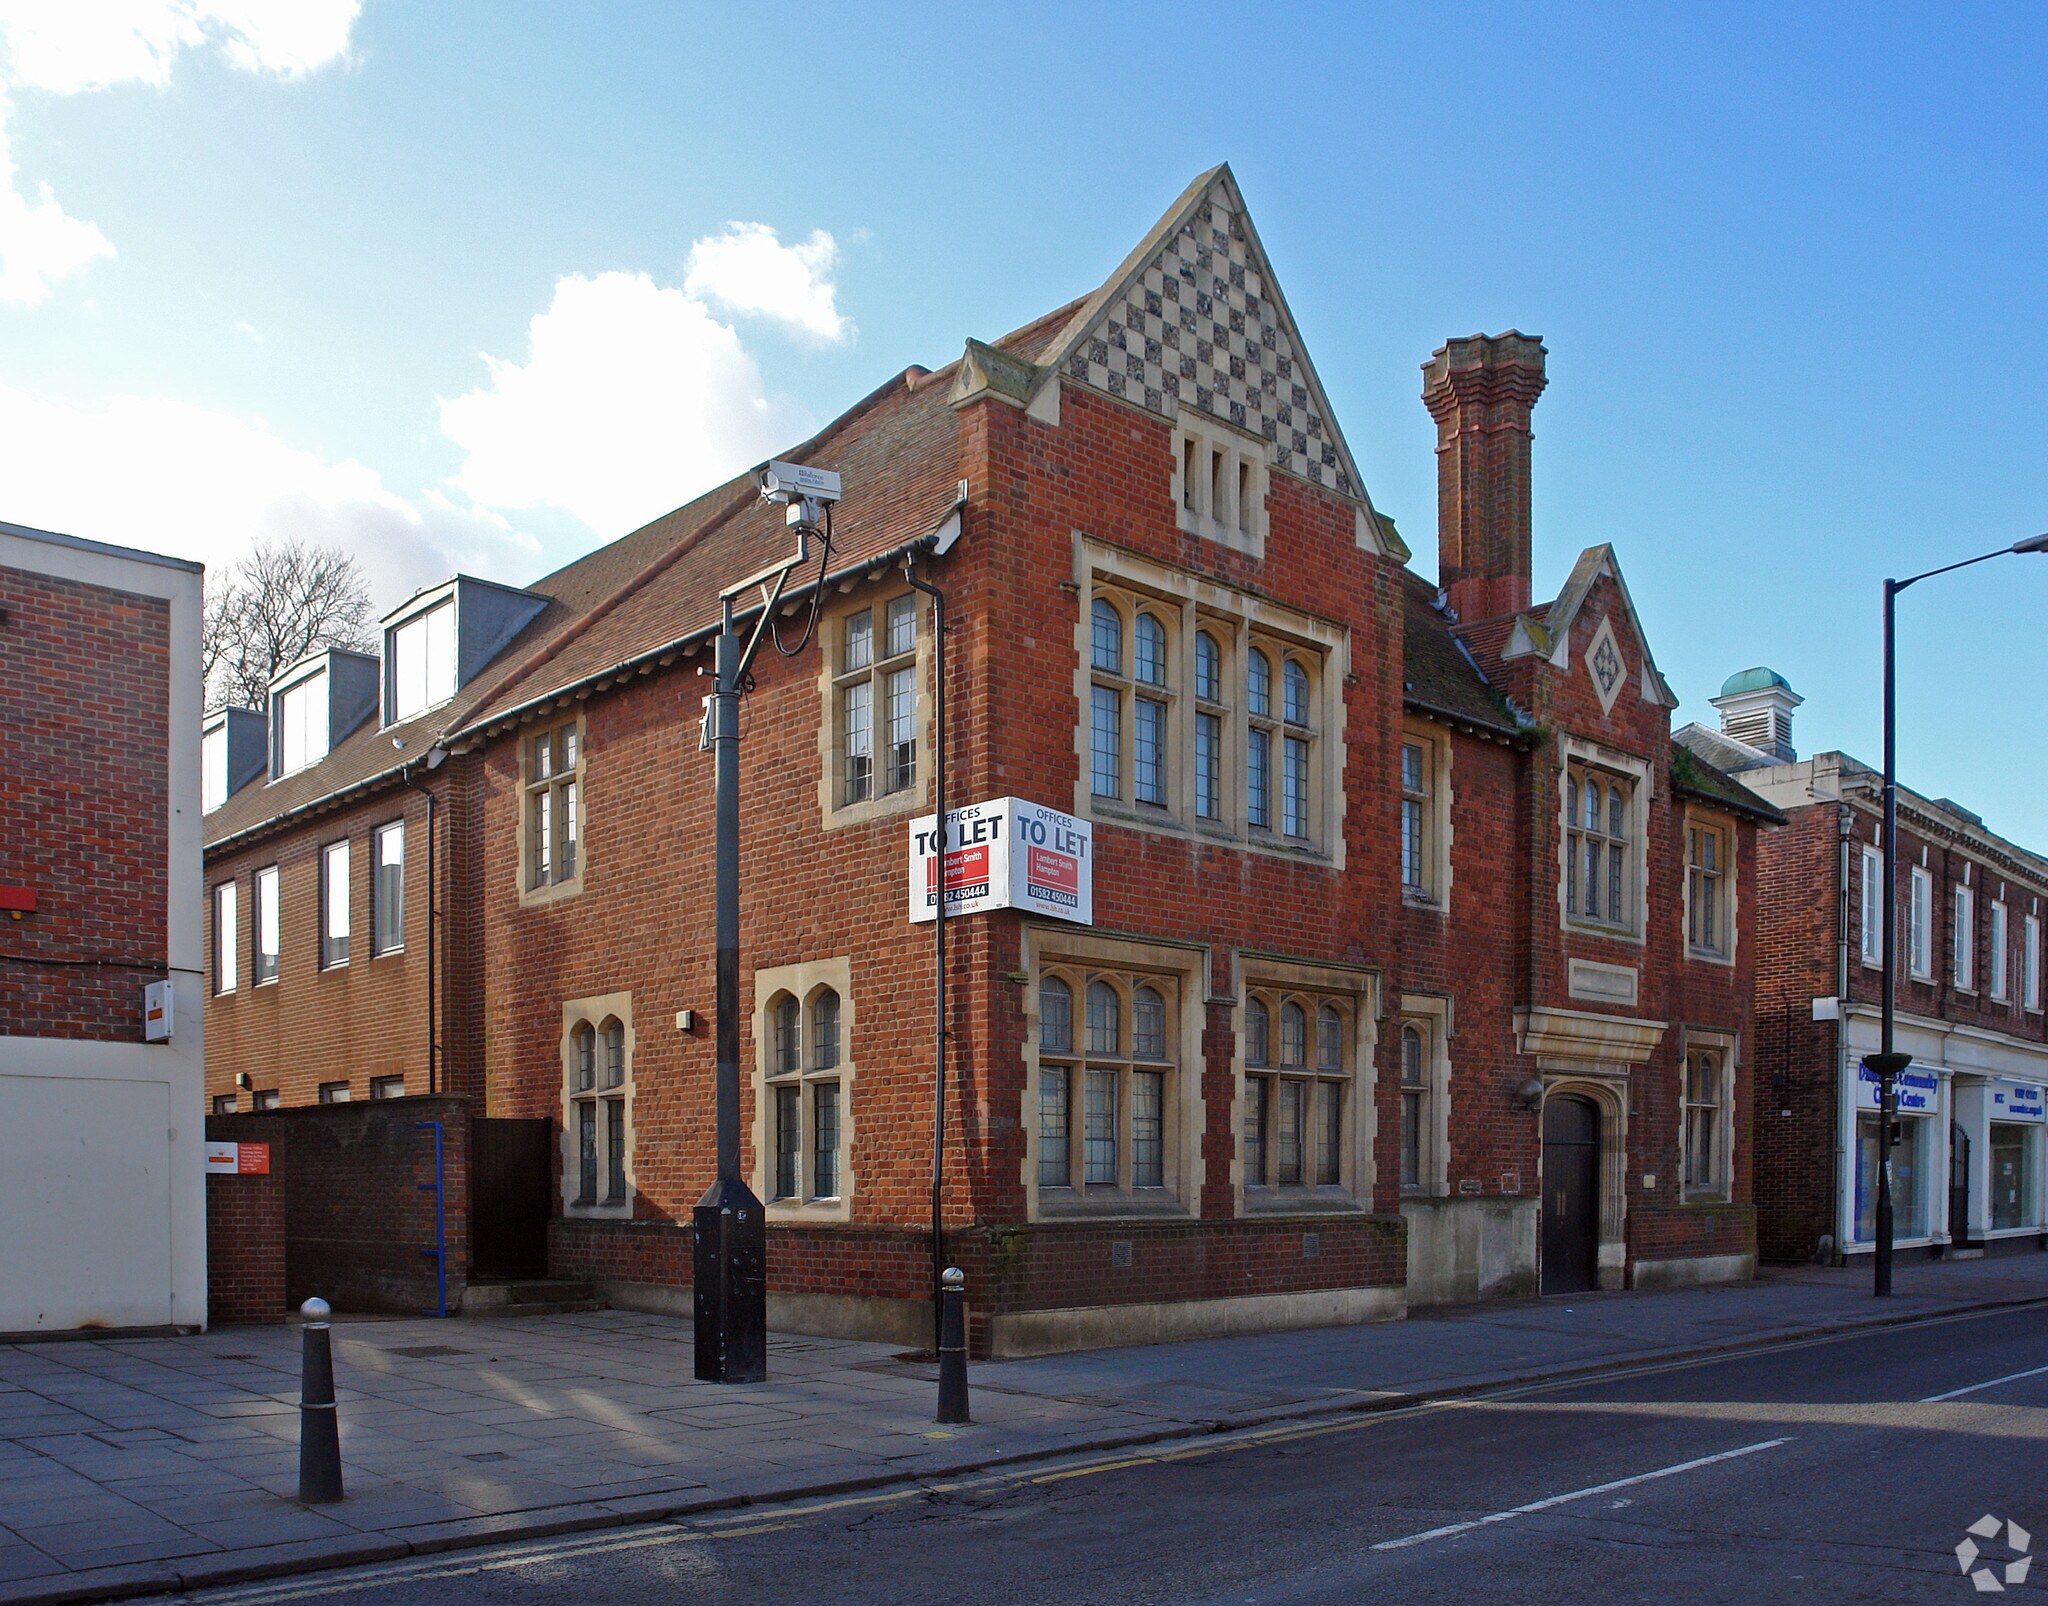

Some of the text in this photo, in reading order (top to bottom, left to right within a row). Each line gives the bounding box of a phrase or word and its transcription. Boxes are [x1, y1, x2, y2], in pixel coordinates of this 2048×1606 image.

[945, 807, 980, 824] FFICES
[1036, 808, 1072, 829] OFFICES
[915, 815, 1003, 856] TO LET
[1017, 815, 1088, 858] TO LET
[963, 851, 982, 863] Smith
[1036, 852, 1073, 871] Lambert Smith
[1036, 863, 1060, 877] Hampton
[930, 885, 986, 905] 082 450444
[1030, 887, 1076, 906] 01582 450444
[1901, 1089, 1926, 1108] Centre
